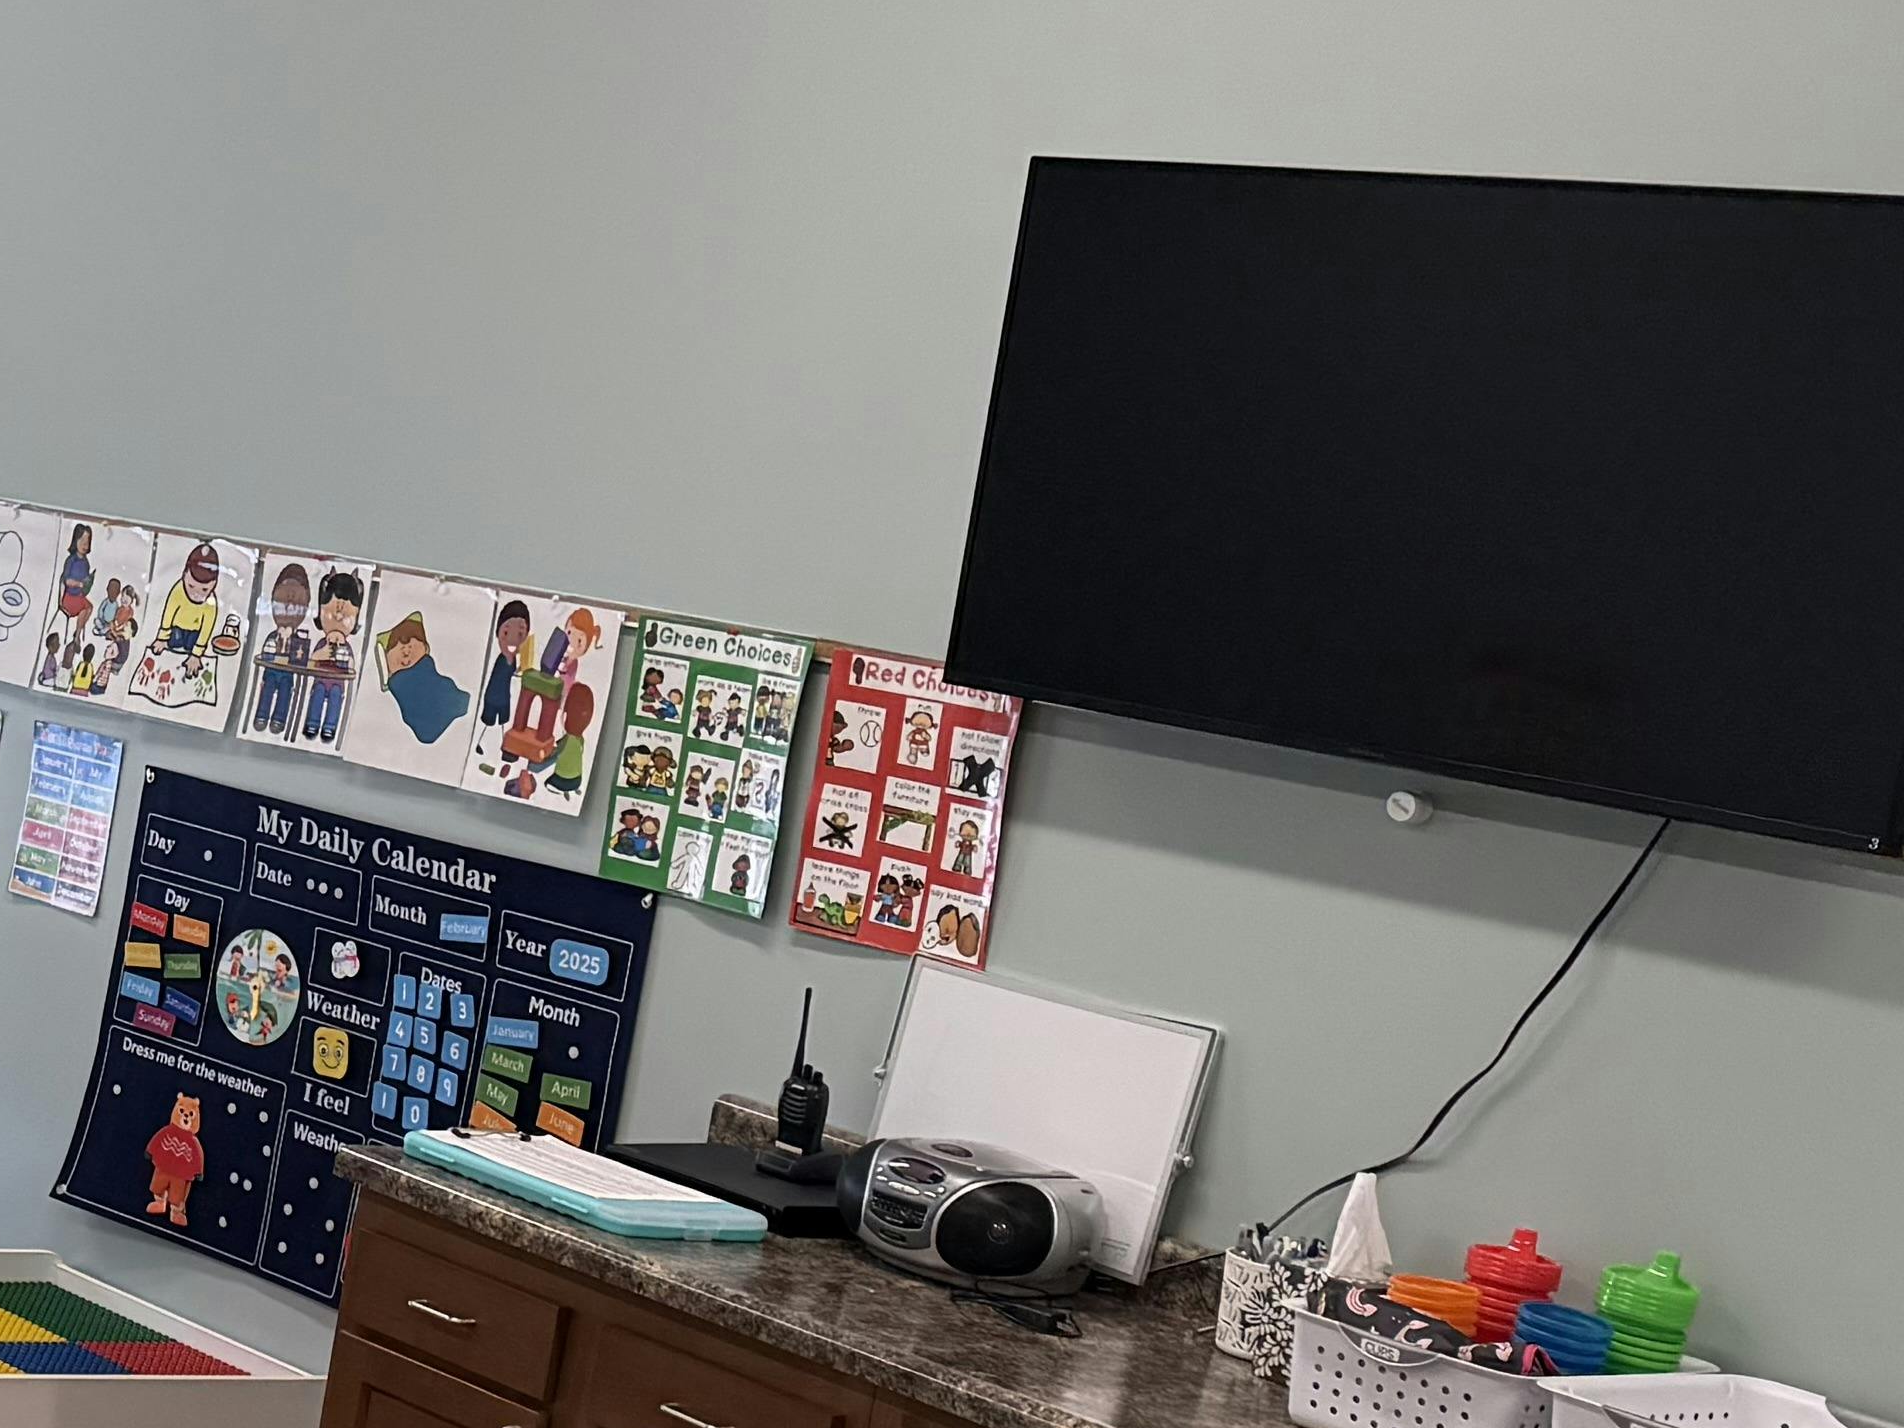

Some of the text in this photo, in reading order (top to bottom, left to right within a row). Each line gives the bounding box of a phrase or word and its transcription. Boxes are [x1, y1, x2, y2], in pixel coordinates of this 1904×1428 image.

[660, 627, 792, 667] Green Choices
[865, 662, 906, 686] Red
[147, 829, 176, 854] Day
[257, 805, 496, 894] My Daily Calendar
[256, 862, 292, 887] Date
[824, 876, 836, 885] the
[835, 866, 860, 880] things
[165, 888, 190, 912] Day
[375, 894, 427, 925] Month
[134, 909, 165, 930] Monday
[442, 923, 485, 938] February
[505, 930, 547, 957] Year
[558, 950, 600, 975] 2025
[421, 966, 463, 994] Dates
[166, 994, 197, 1018] Saturday
[307, 990, 380, 1030] Weather
[425, 993, 434, 1010] 2
[459, 1003, 466, 1019] 3
[528, 996, 580, 1027] Month
[138, 1009, 170, 1031] Sunday
[395, 1023, 459, 1060] 4 5 6
[492, 1025, 535, 1042] January
[123, 1037, 267, 1099] Dress me for the weather
[491, 1052, 524, 1072] March
[391, 1054, 452, 1097] 7 8 9
[304, 1083, 350, 1115] I feel
[486, 1084, 509, 1106] May
[551, 1084, 580, 1100] April
[410, 1106, 420, 1122] 0
[549, 1112, 575, 1133] June
[294, 1122, 345, 1155] Weathe
